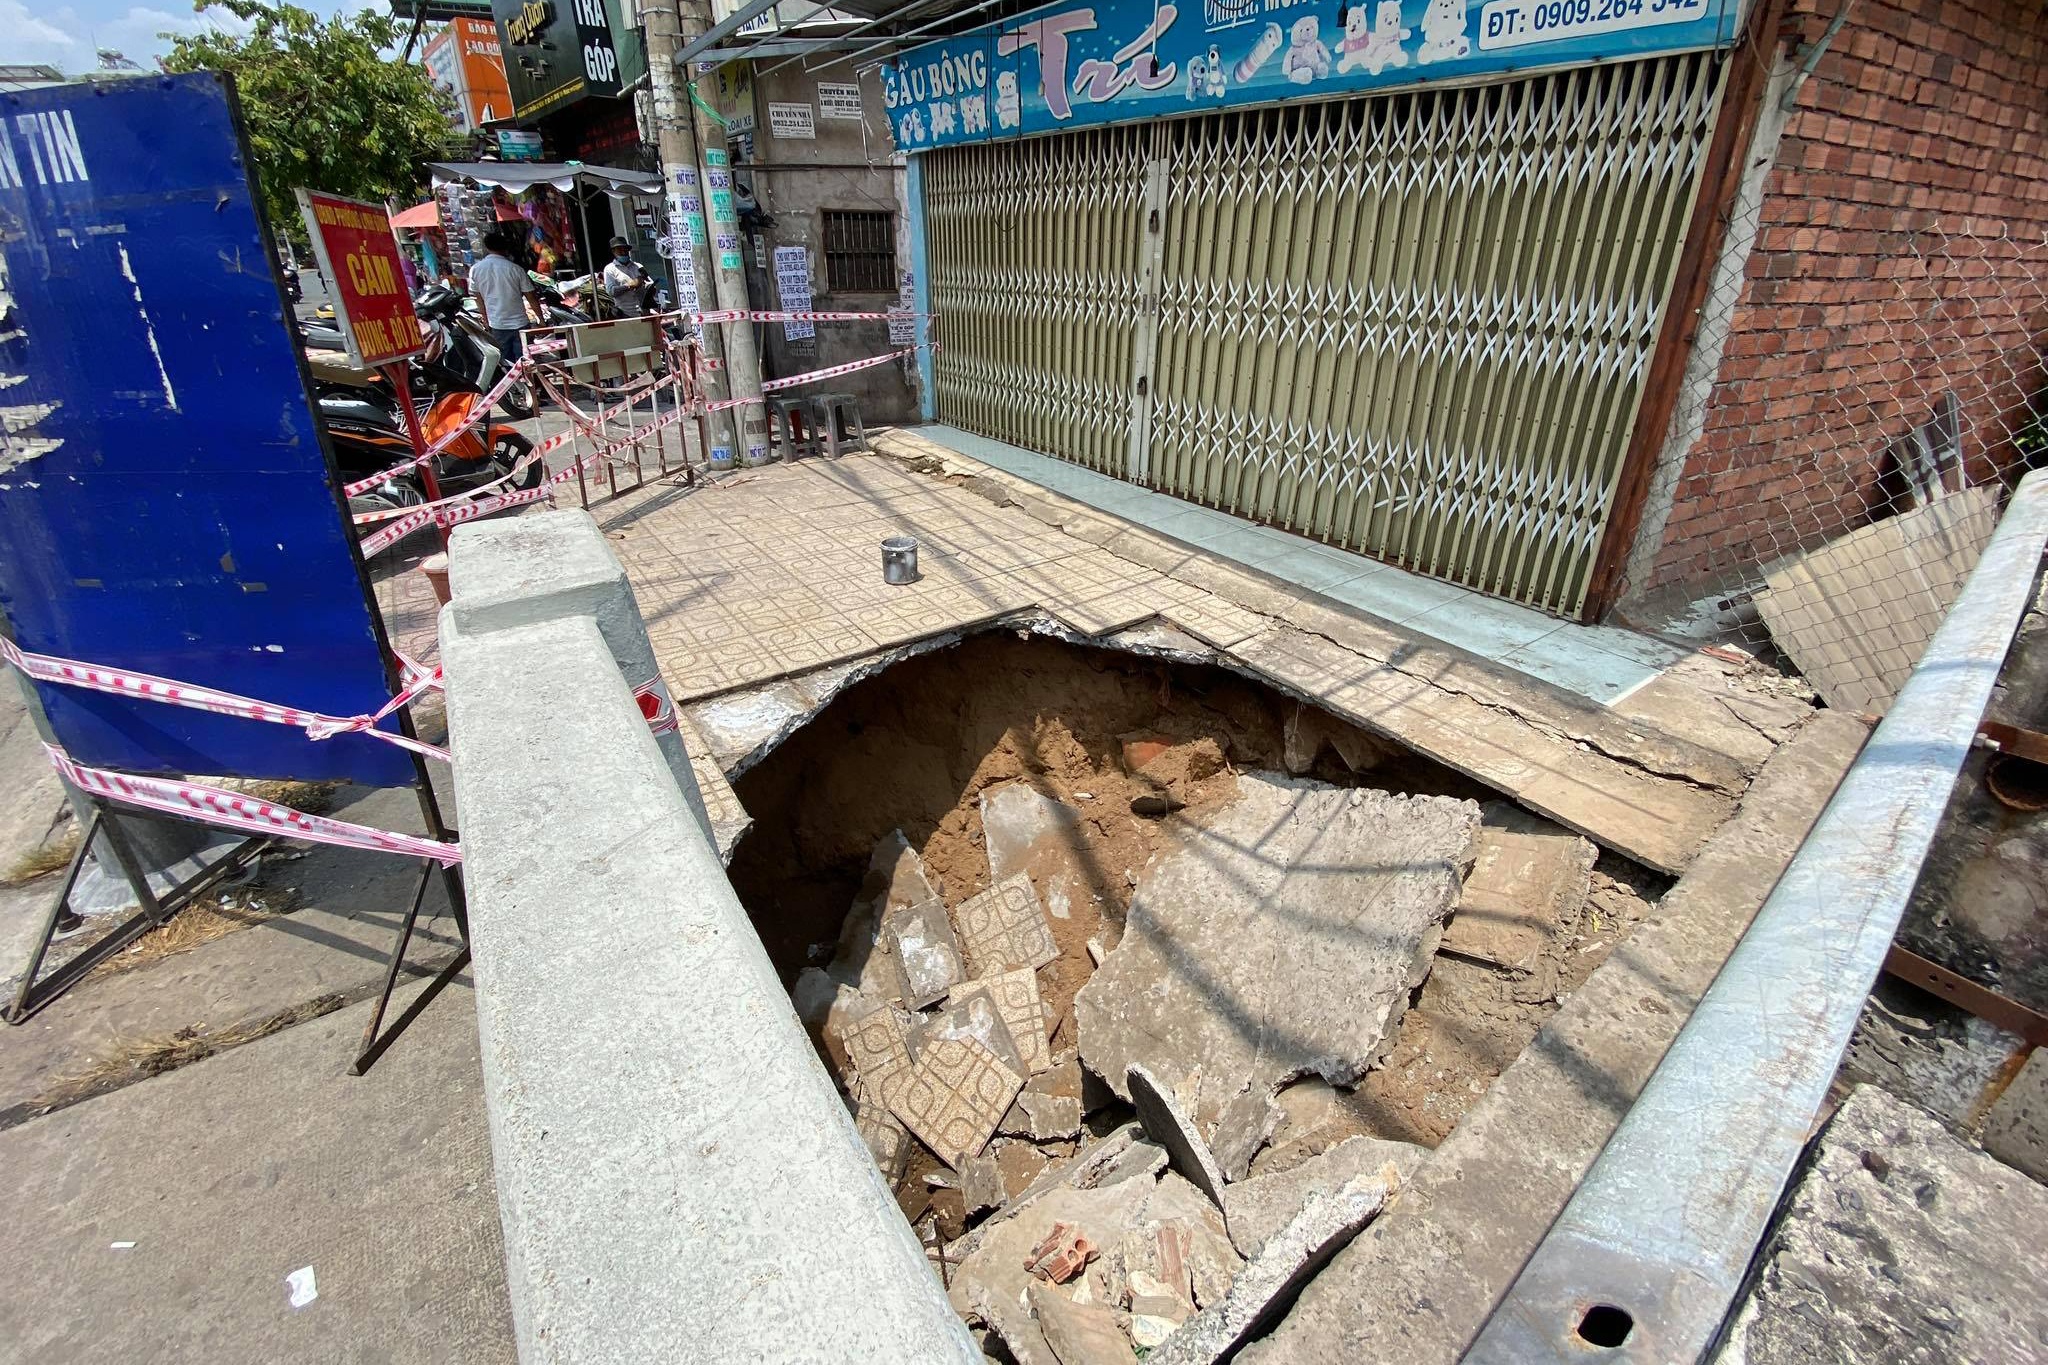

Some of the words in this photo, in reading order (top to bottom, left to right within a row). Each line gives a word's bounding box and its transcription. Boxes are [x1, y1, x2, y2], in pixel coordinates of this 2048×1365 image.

[1488, 9, 1526, 38] ĐT:
[584, 38, 616, 82] GÓP
[884, 60, 927, 108] GẤU
[928, 49, 987, 99] BÔNG
[998, 4, 1178, 120] Trí
[15, 110, 90, 185] TIN
[346, 240, 399, 297] CẤM
[389, 304, 411, 349] ĐỖ
[408, 315, 423, 347] XE
